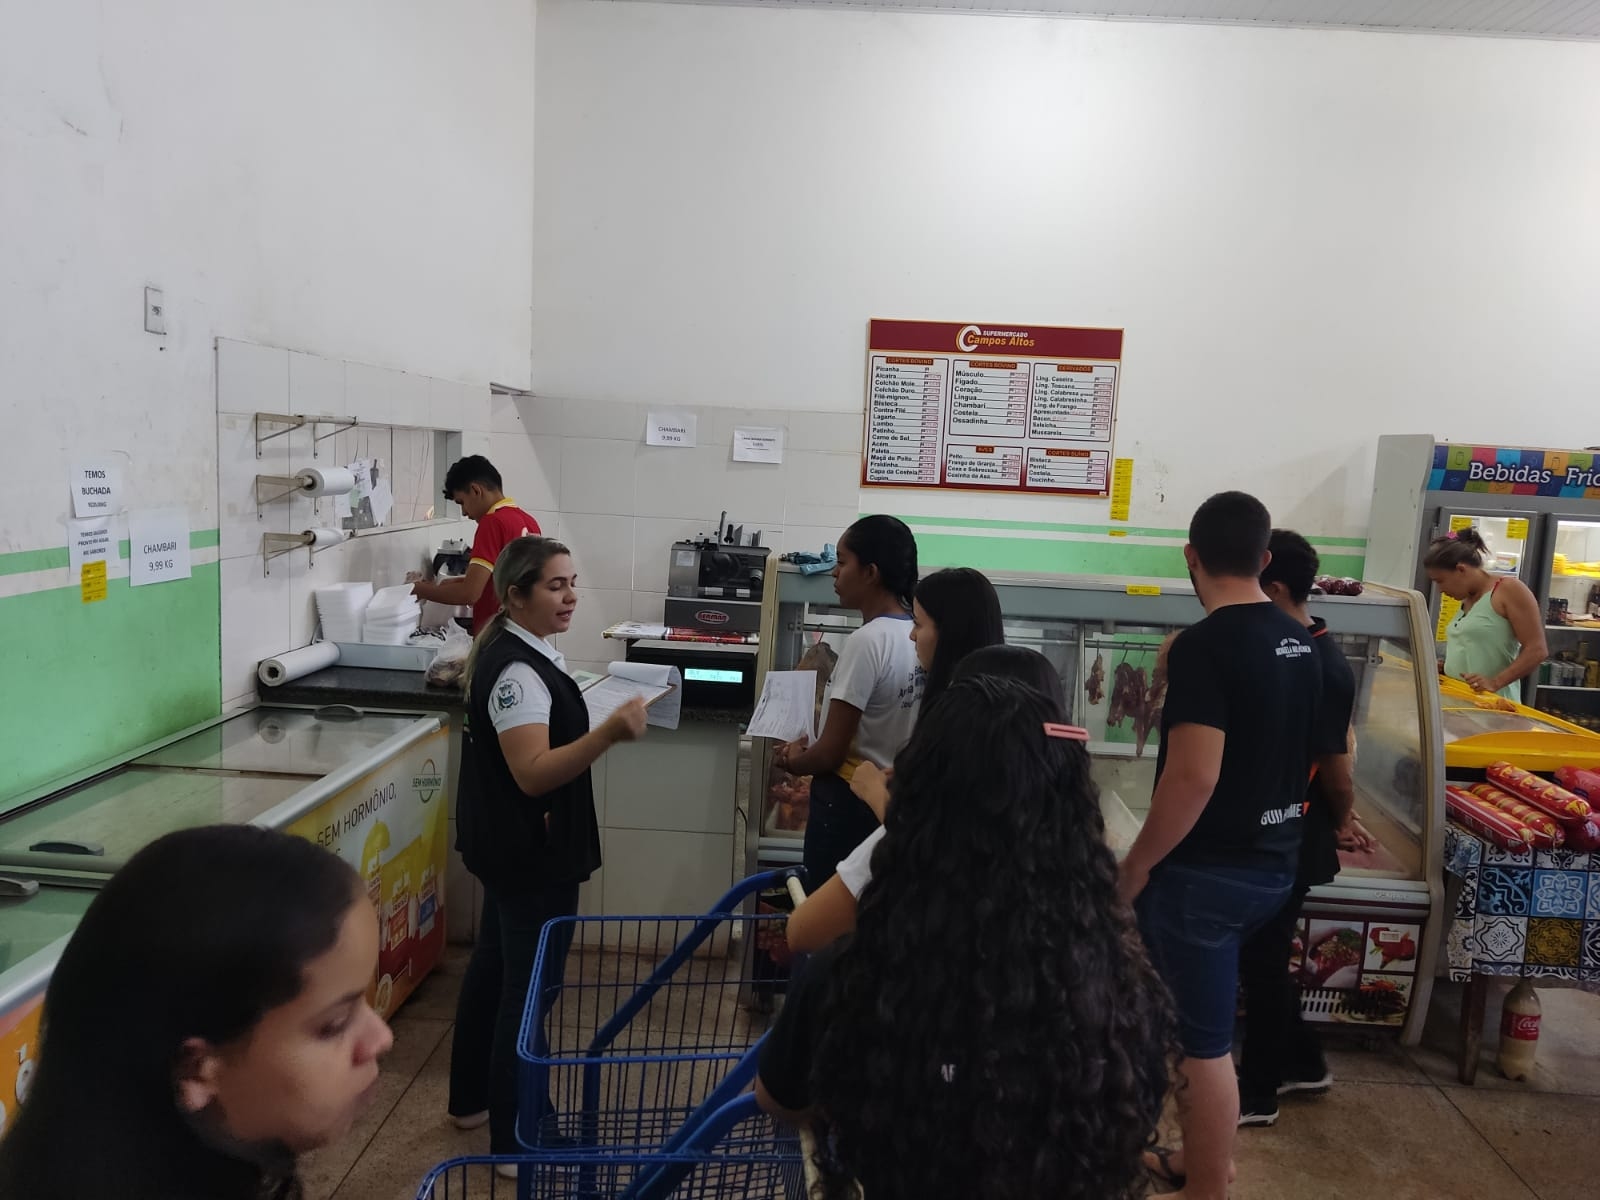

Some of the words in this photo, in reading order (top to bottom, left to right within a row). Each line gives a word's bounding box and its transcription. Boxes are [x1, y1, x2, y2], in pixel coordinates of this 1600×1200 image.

[967, 334, 1006, 346] Campos
[1008, 337, 1035, 347] Altos
[85, 470, 106, 479] TEMOS
[1469, 462, 1552, 483] Bebidas
[82, 487, 111, 495] BUCHADA
[143, 542, 177, 554] CHAMBARI
[149, 561, 163, 573] 9,99
[164, 560, 174, 569] KG
[317, 818, 340, 849] SEM
[344, 782, 396, 834] HORMÔNIO,
